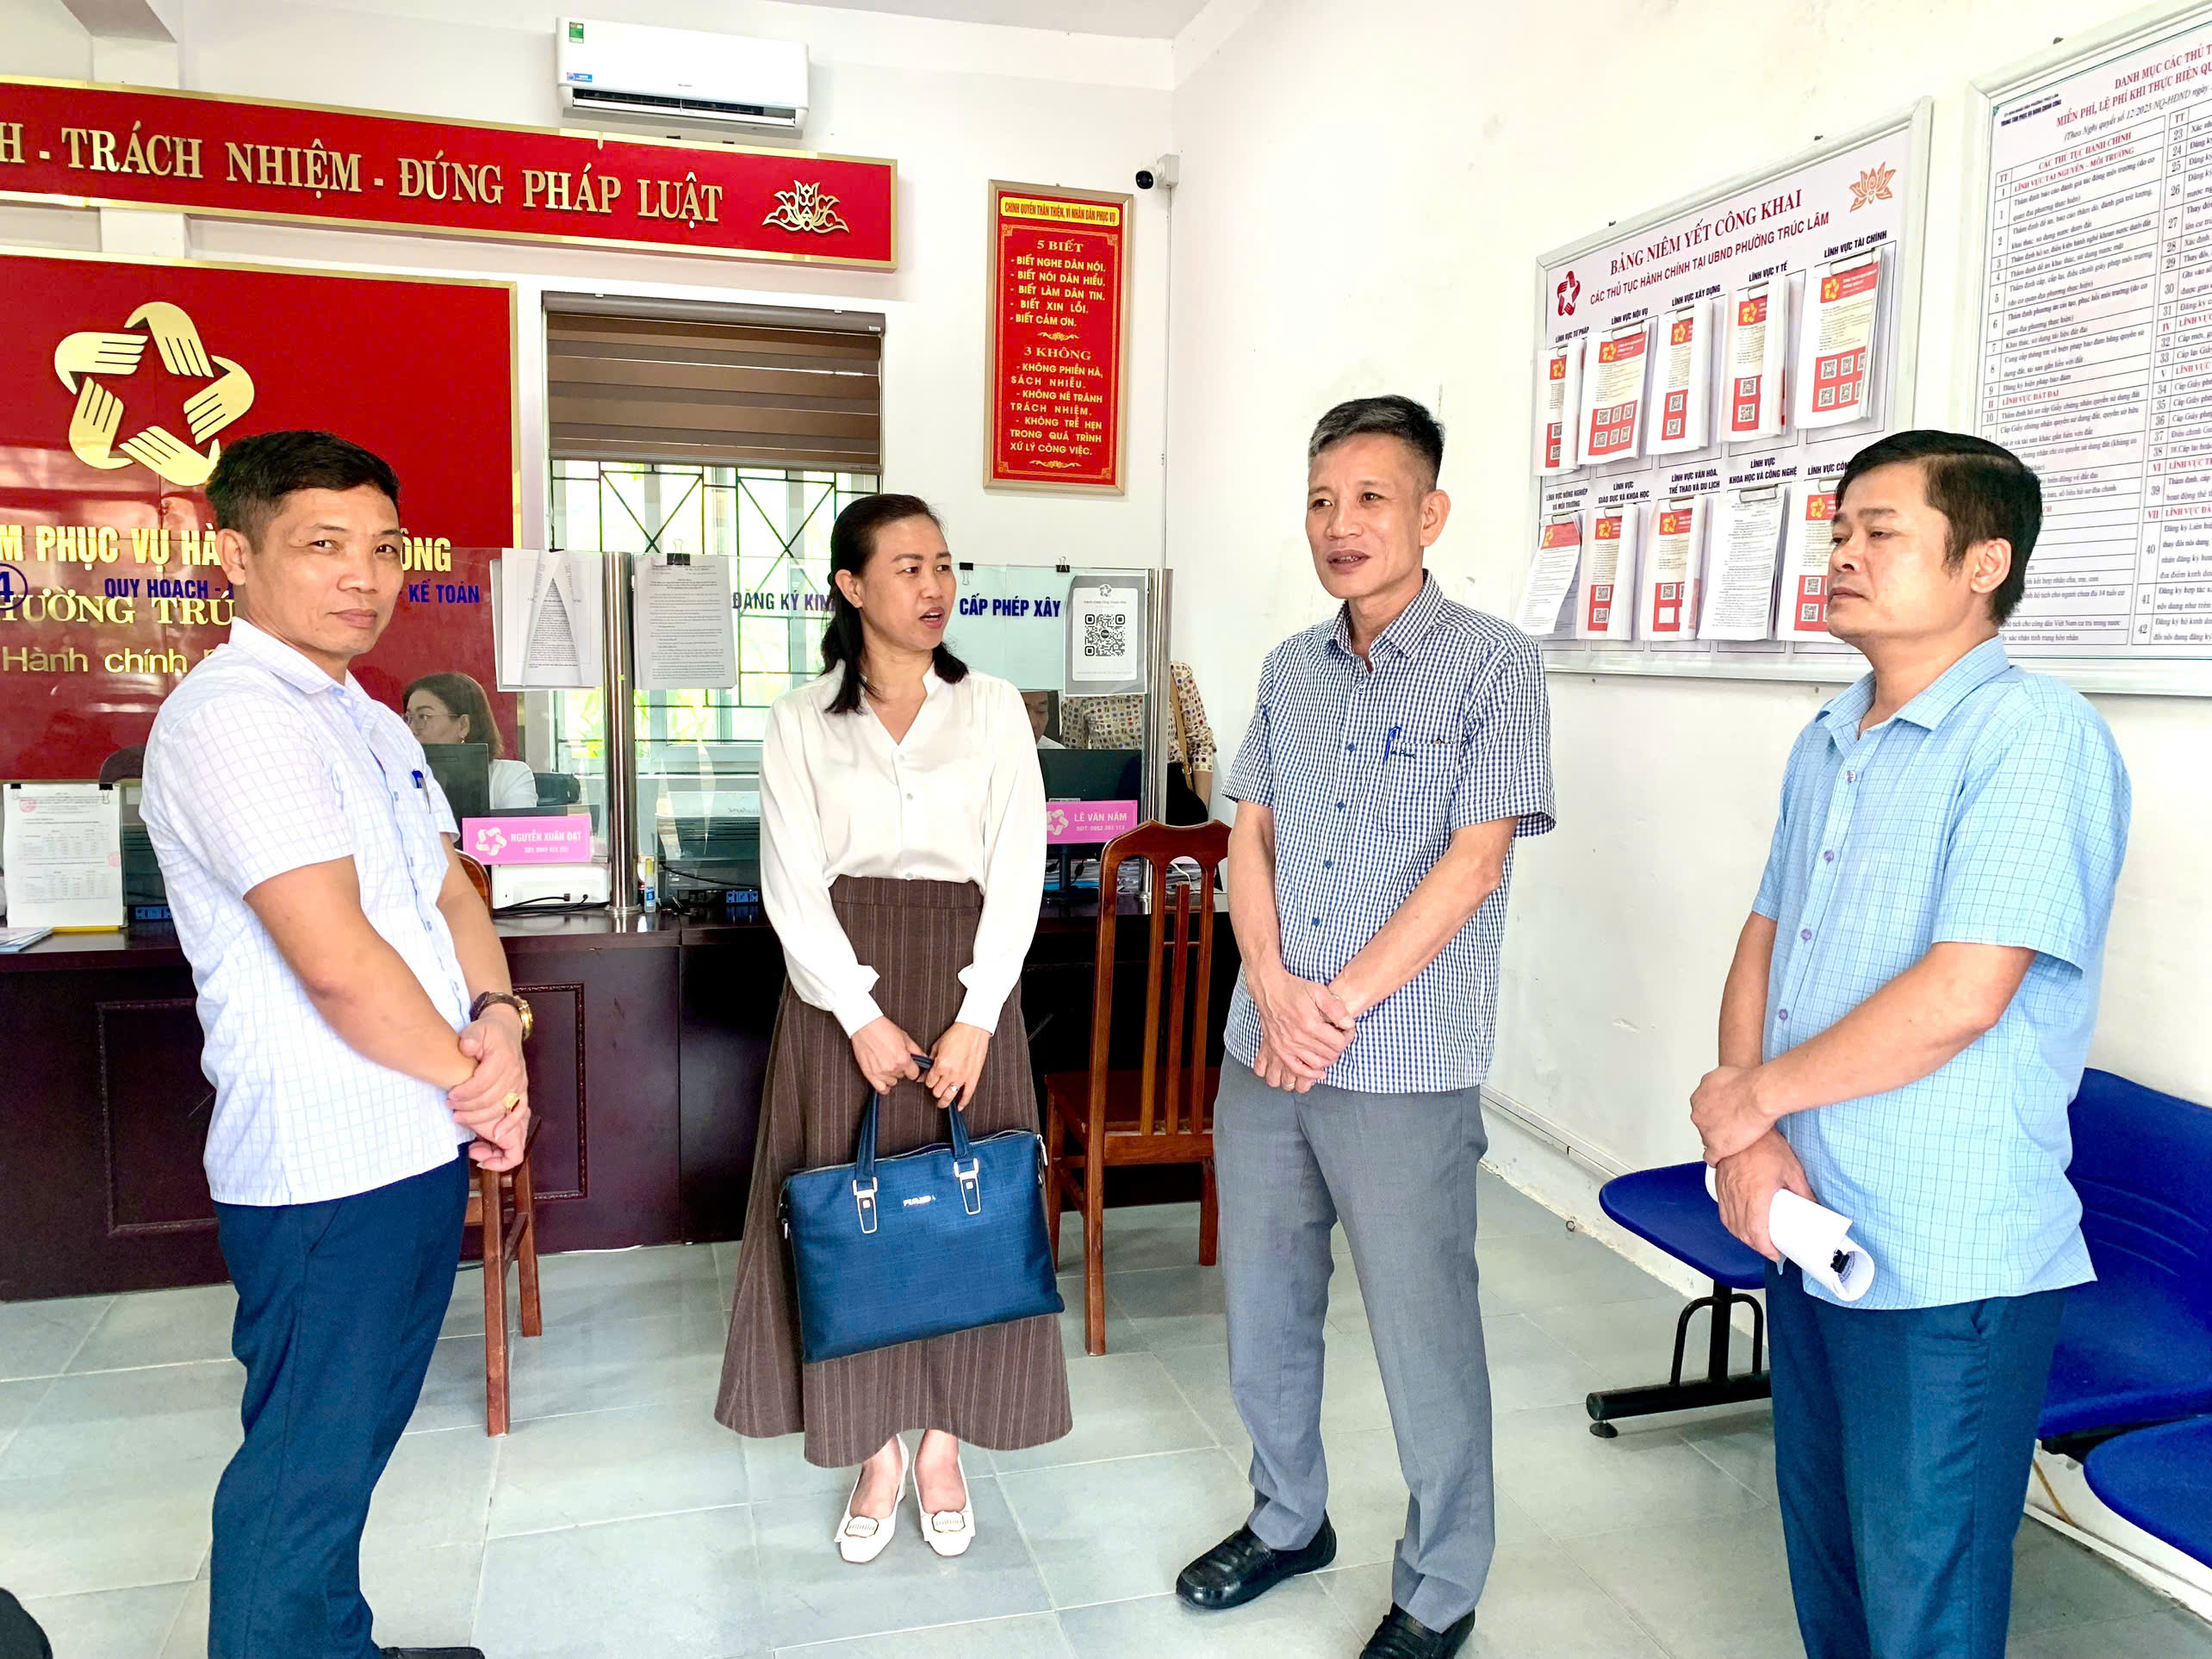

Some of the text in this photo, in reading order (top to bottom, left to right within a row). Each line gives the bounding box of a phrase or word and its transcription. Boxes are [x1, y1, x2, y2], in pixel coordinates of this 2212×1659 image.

[2173, 128, 2183, 140] 23
[2172, 145, 2182, 156] 24
[2172, 160, 2181, 172] 25
[62, 121, 202, 178] TRÁCH
[226, 139, 362, 198] NHIỆM
[399, 151, 504, 204] ĐÚNG
[522, 163, 621, 214] PHÁP
[637, 171, 723, 229] LUẬT
[2171, 184, 2180, 196] 26
[2168, 217, 2178, 228] 27
[1610, 251, 1644, 276] BẢNG
[1684, 218, 1712, 248] YẾT
[1714, 207, 1756, 236] CÔNG
[1760, 189, 1802, 221] KHAI
[1037, 239, 1084, 252] 5 BIẾT
[1016, 253, 1106, 272] BIẾT NGHE DÂN NÓI.
[1590, 211, 1830, 305] CÁC THỦ TỤC HÀNH CHÍNH TẠI UBND PHƯỜNG TRÚC LÂM
[1017, 268, 1035, 280] BIẾT
[1039, 270, 1056, 283] NÓI
[1059, 273, 1079, 284] DÂN
[1018, 283, 1106, 301] BIẾT LÀM DÂN TIN.
[2165, 283, 2174, 295] 30
[1020, 297, 1040, 309] BIẾT
[1047, 301, 1064, 312] XIN
[1016, 312, 1034, 324] BIẾT
[1059, 315, 1078, 327] ƠN.
[1024, 346, 1091, 360] 3 KHÔNG
[1022, 362, 1057, 373] KHÔNG
[1022, 388, 1103, 404] KHÔNG NÉ TRÁNH
[1010, 401, 1047, 413] TRÁCH
[1024, 415, 1059, 426] KHÔNG
[1084, 420, 1103, 432] HẸN
[0, 525, 24, 561] M
[36, 525, 119, 570] PHỤC
[131, 527, 170, 572] VỤ
[104, 578, 140, 599] QUY
[408, 579, 431, 603] KẾ
[436, 581, 480, 603] TOÁN
[732, 588, 774, 610] ĐĂNG
[780, 589, 799, 610] KÝ
[960, 593, 1061, 617] CẤP PHÉP XÂY
[152, 590, 234, 626] TRÚ
[3, 647, 88, 672] Hành
[105, 648, 188, 674] chính
